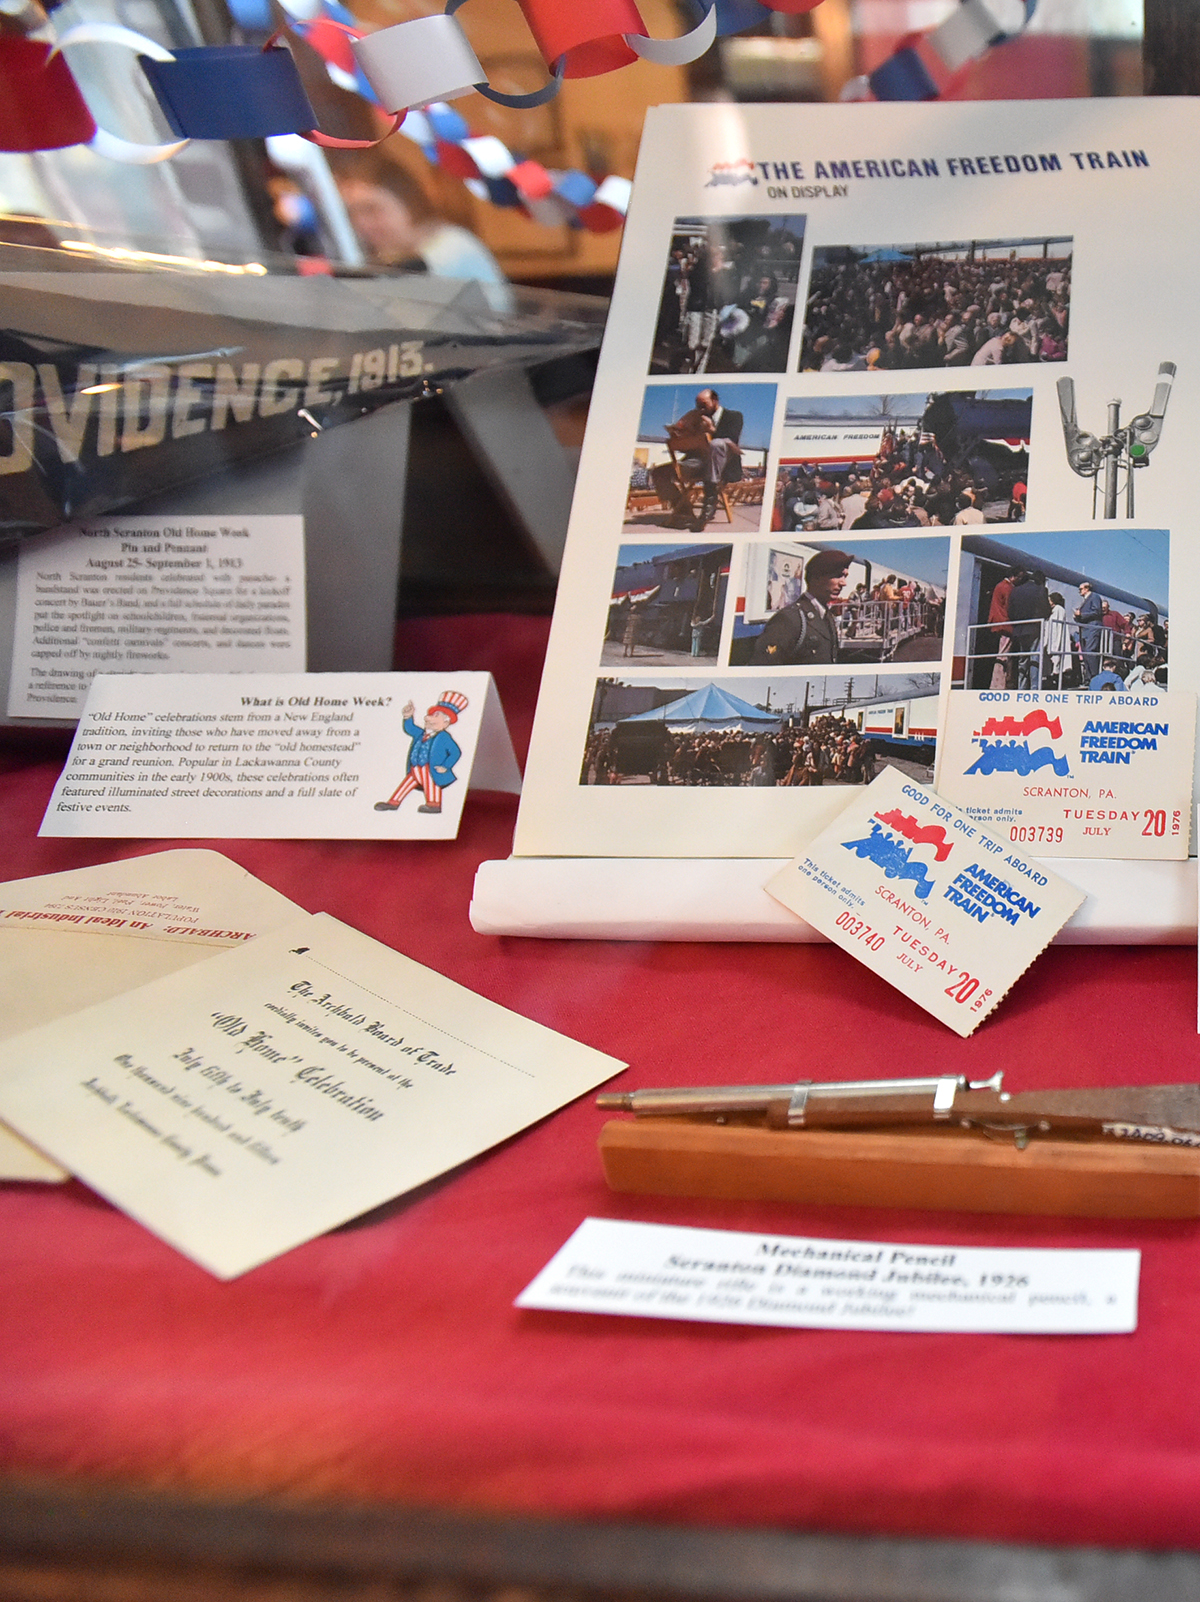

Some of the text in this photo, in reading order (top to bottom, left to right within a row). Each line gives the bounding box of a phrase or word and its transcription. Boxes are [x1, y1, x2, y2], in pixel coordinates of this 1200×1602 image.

[757, 149, 1150, 180] THE AMERICAN FREEDOM TRAIN
[767, 184, 848, 198] ON DISPLAY
[113, 528, 160, 538] Scranton
[162, 528, 183, 537] Old
[185, 528, 217, 538] Home
[219, 527, 250, 538] Week
[241, 697, 392, 707] What is Old Home Week?
[979, 692, 1158, 706] GOOD FOR ONE TRIP ABOARD
[88, 712, 112, 721] “Old
[115, 711, 152, 722] Home”
[155, 712, 217, 721] celebrations
[247, 713, 271, 721] from
[284, 713, 307, 721] New
[310, 713, 353, 723] England
[1082, 721, 1169, 736] AMERICAN
[1080, 736, 1157, 750] FREEDOM
[1023, 787, 1117, 799] SCRANTON, PA.
[966, 807, 1023, 815] ticket admits
[1063, 809, 1166, 837] TUESDAY 20
[1172, 810, 1181, 836] 1976
[901, 784, 1048, 886] GOOD FOR ONE TRIP ABOARD
[1010, 826, 1064, 843] 003739
[1083, 827, 1111, 836] JULY
[798, 865, 854, 908] one person only.
[803, 858, 866, 906] This ticket admits
[963, 863, 1041, 918] AMERICAN
[952, 873, 1020, 926] FREEDOM
[6, 910, 257, 941] ARCHBALD: An Ideal Industrial
[875, 885, 949, 945] SCRANTON, PA.
[835, 911, 885, 951] 003740
[893, 925, 980, 1004] TUESDAY 20
[897, 953, 923, 973] JULY
[970, 988, 993, 1012] 1976
[287, 980, 314, 998] The
[307, 993, 367, 1026] Archbald
[358, 1021, 405, 1048] Board
[414, 1050, 457, 1076] Trade
[290, 1066, 385, 1122] Celebration
[758, 1242, 957, 1267] Mechanical Pencil
[664, 1255, 765, 1276] Scranton
[776, 1263, 875, 1281] Diamond
[979, 1274, 1029, 1288] 1926
